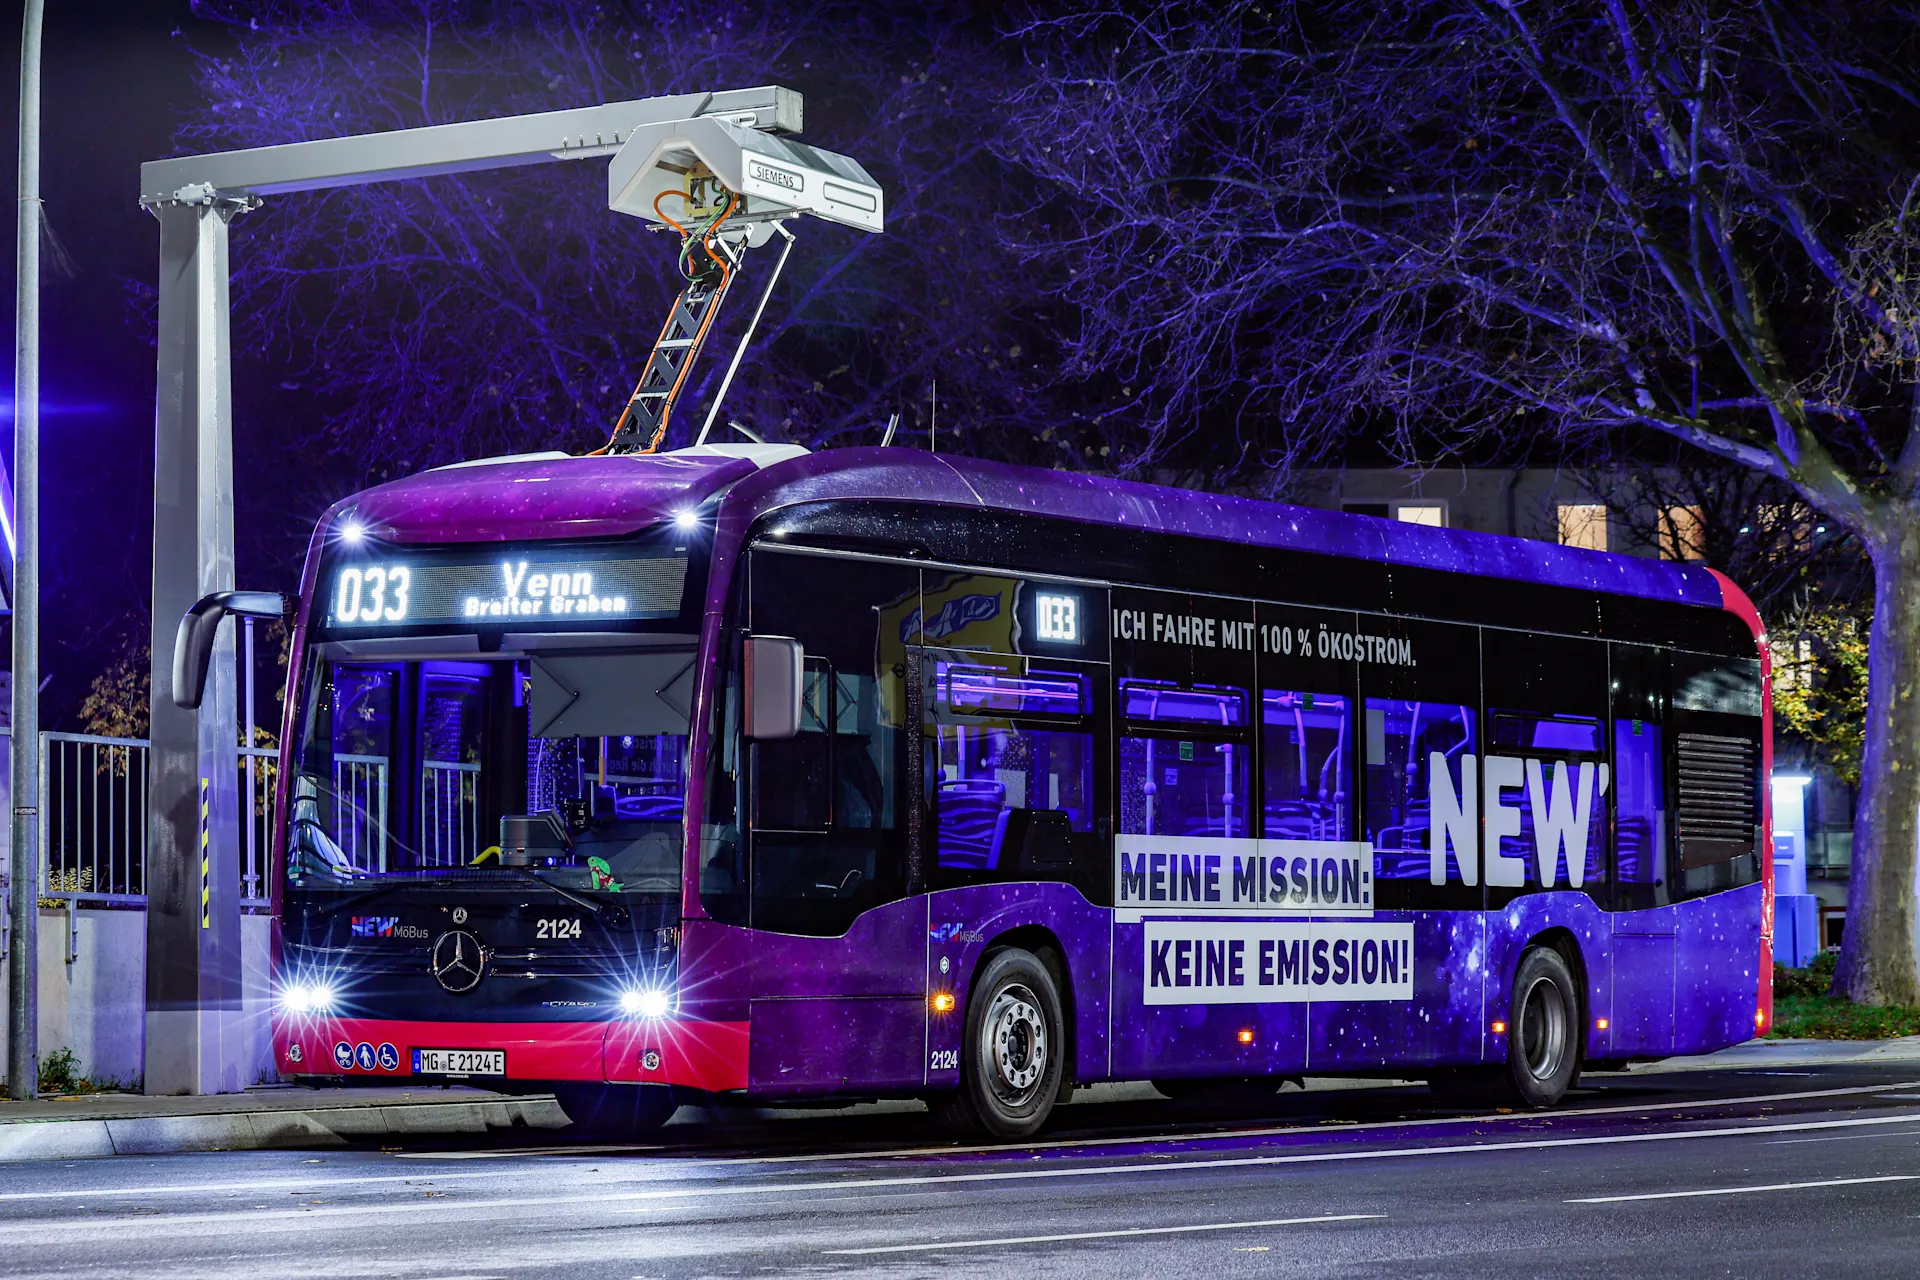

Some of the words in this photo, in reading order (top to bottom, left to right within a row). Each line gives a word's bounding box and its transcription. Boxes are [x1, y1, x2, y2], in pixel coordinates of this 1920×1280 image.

[756, 167, 794, 188] SIEMENS
[501, 561, 594, 597] Venn
[335, 565, 411, 623] 033
[464, 597, 543, 617] Breiter
[550, 594, 626, 614] Graben
[1038, 595, 1076, 640] 033
[1113, 608, 1147, 641] ICH
[1152, 614, 1216, 648] FAHRE
[1222, 619, 1255, 651] MIT
[1260, 624, 1293, 655] 100
[1297, 627, 1312, 657] %
[1317, 622, 1417, 667] ÖKOSTROM.
[1120, 852, 1222, 902] MEINE
[1232, 855, 1370, 904] MISSION:
[393, 925, 429, 938] MöBus
[536, 919, 582, 939] 2124
[959, 930, 984, 943] MöBus
[1150, 939, 1245, 987] KEINE
[1258, 938, 1409, 986] EMISSION!
[421, 1052, 439, 1071] MG
[931, 1050, 957, 1069] 2124
